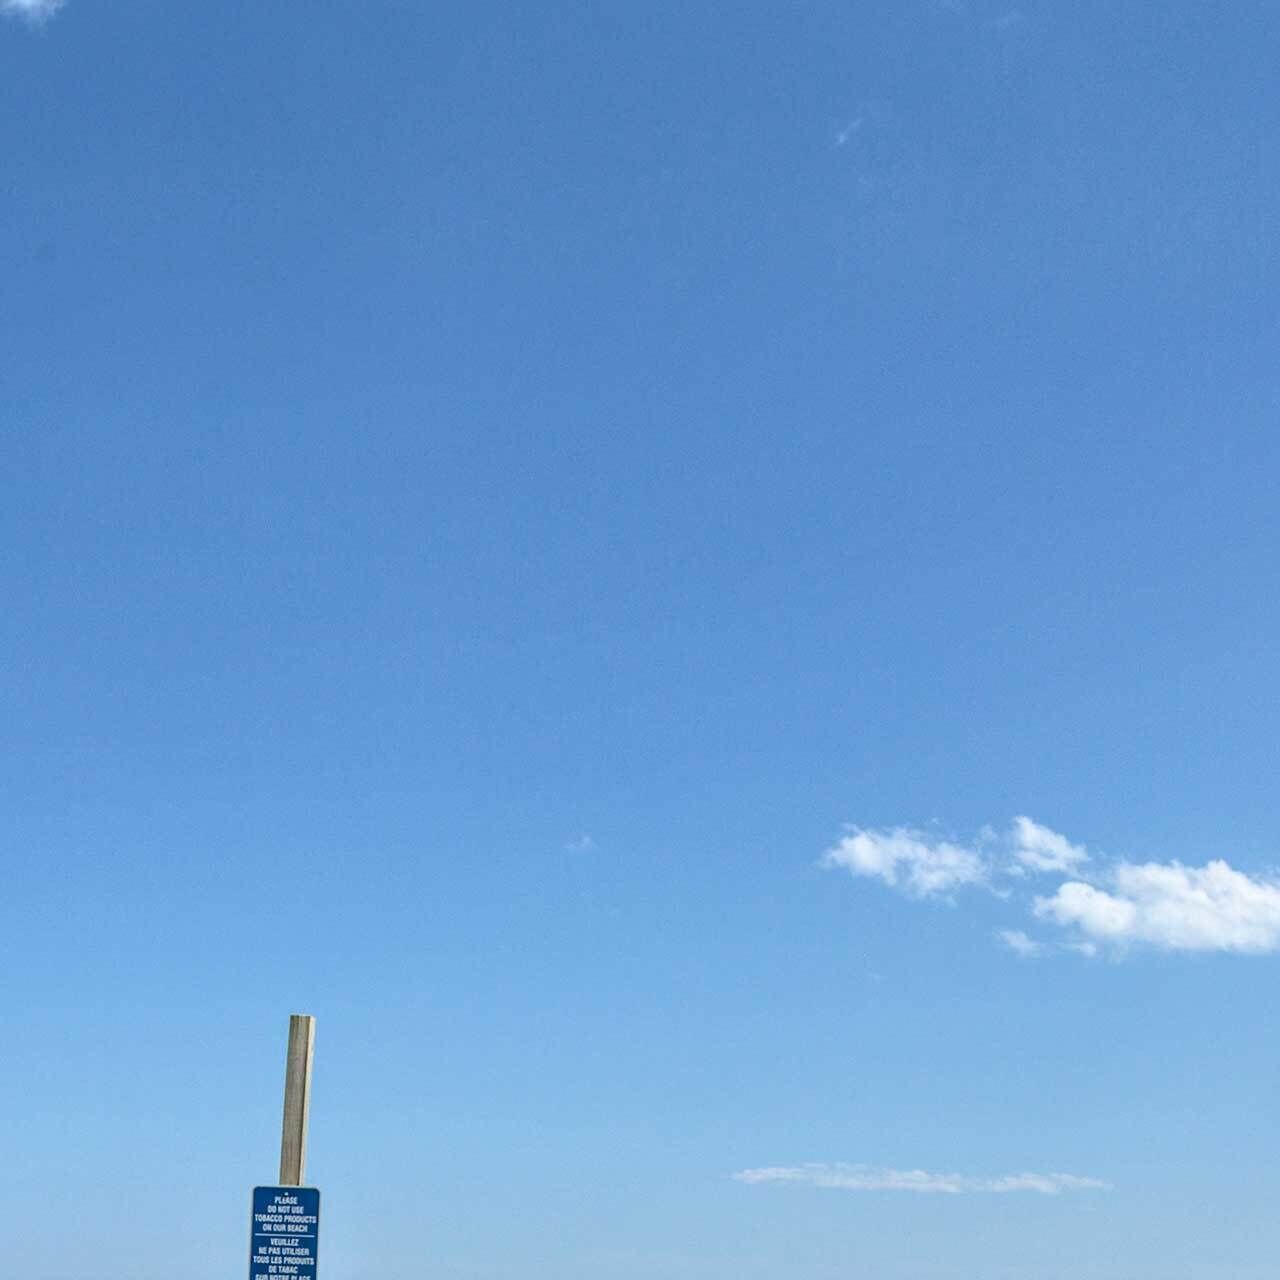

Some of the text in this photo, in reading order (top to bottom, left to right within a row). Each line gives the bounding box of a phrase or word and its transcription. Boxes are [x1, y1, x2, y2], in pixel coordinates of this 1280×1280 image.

[274, 1196, 298, 1205] PLEASE
[267, 1205, 304, 1214] DO NOT USE
[255, 1214, 317, 1224] TOBACCO PRODUCTS
[262, 1223, 308, 1232] ON OUR BEACH
[270, 1238, 299, 1246] VEUILLEZ
[258, 1246, 310, 1255] NE PAS UTILISER
[253, 1255, 314, 1265] TOUS LES PRODUITS
[268, 1265, 298, 1274] DE TABAC
